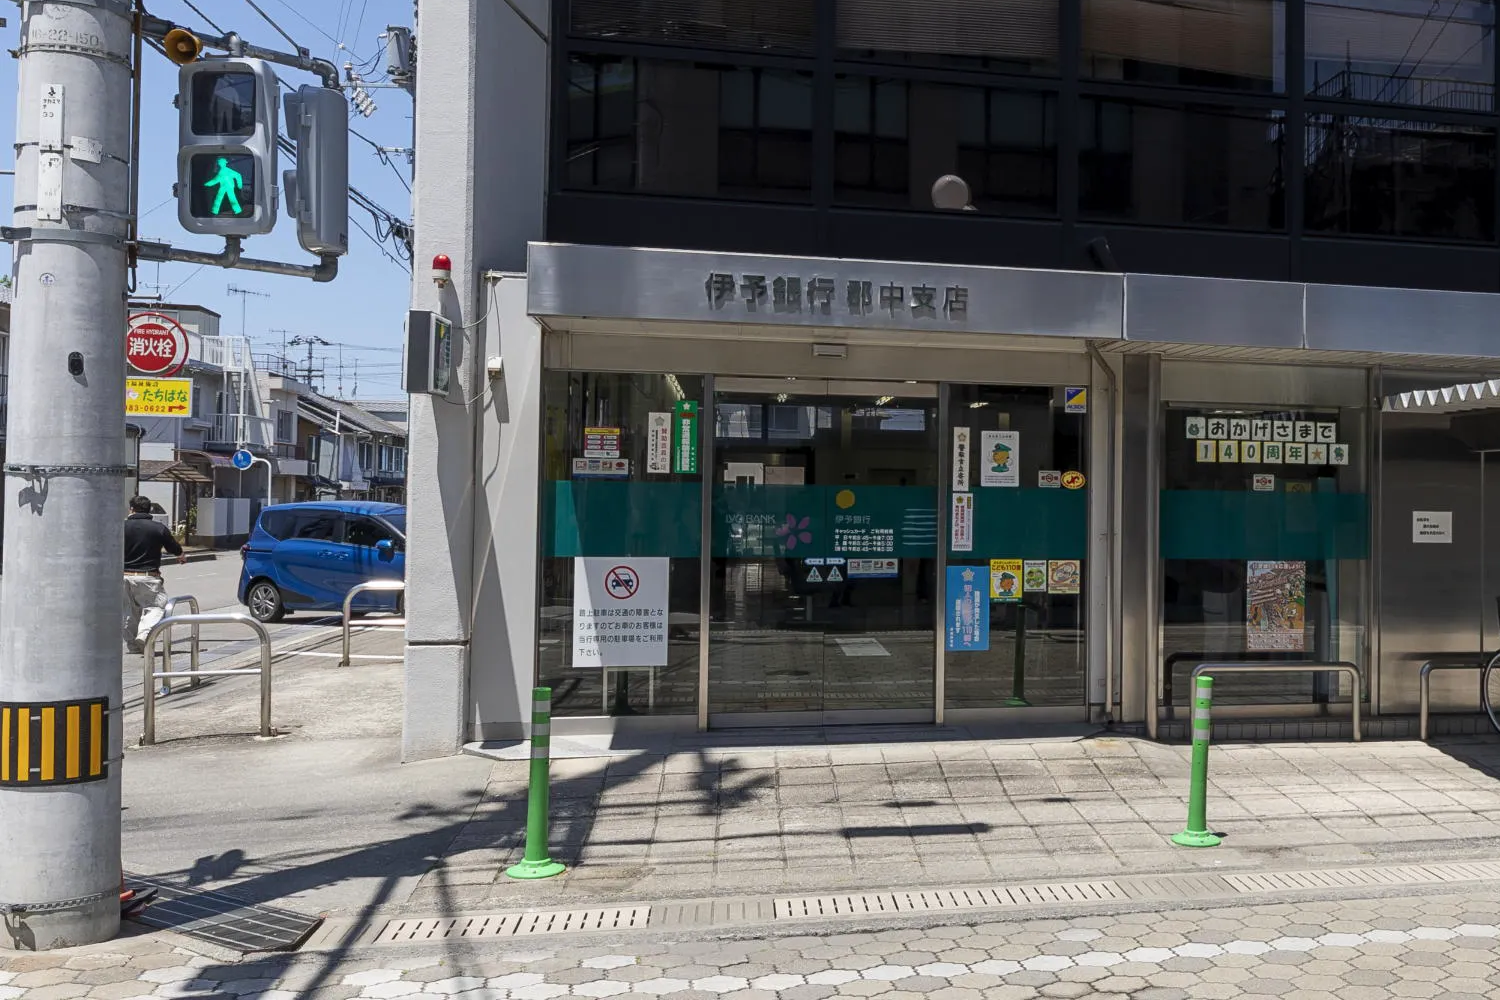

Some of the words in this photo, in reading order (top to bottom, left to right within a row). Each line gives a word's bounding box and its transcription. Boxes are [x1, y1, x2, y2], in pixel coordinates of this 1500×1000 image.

[705, 272, 834, 308] 伊予銀行
[847, 281, 969, 314] 郡中支店
[128, 337, 174, 358] 消火栓
[126, 404, 166, 413] 83-0622
[1211, 421, 1332, 439] おかげさまで
[1203, 444, 1302, 461] 140周年
[746, 514, 776, 524] BANK
